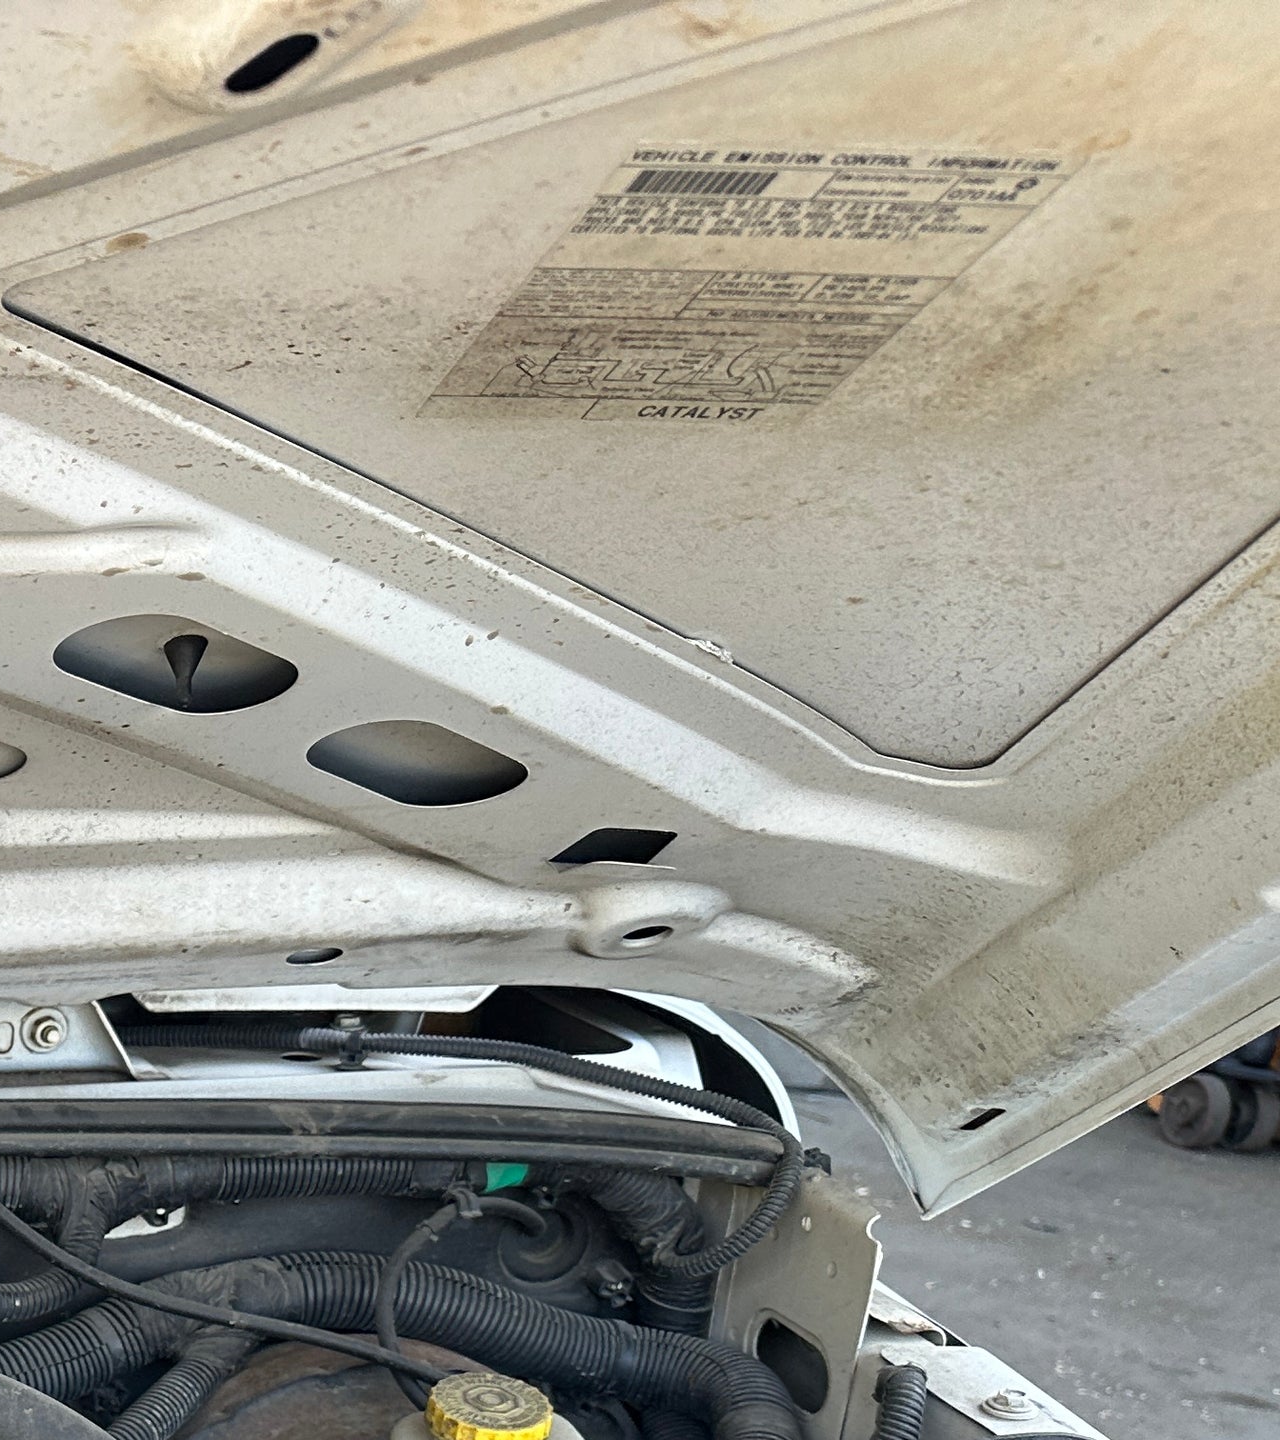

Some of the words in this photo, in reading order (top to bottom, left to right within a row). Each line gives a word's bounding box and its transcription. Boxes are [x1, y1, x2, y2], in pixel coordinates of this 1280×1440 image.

[631, 148, 717, 162] VEHICLE
[724, 151, 825, 164] EMISSION
[831, 153, 911, 167] CONTROL
[638, 405, 765, 420] CATALYST
